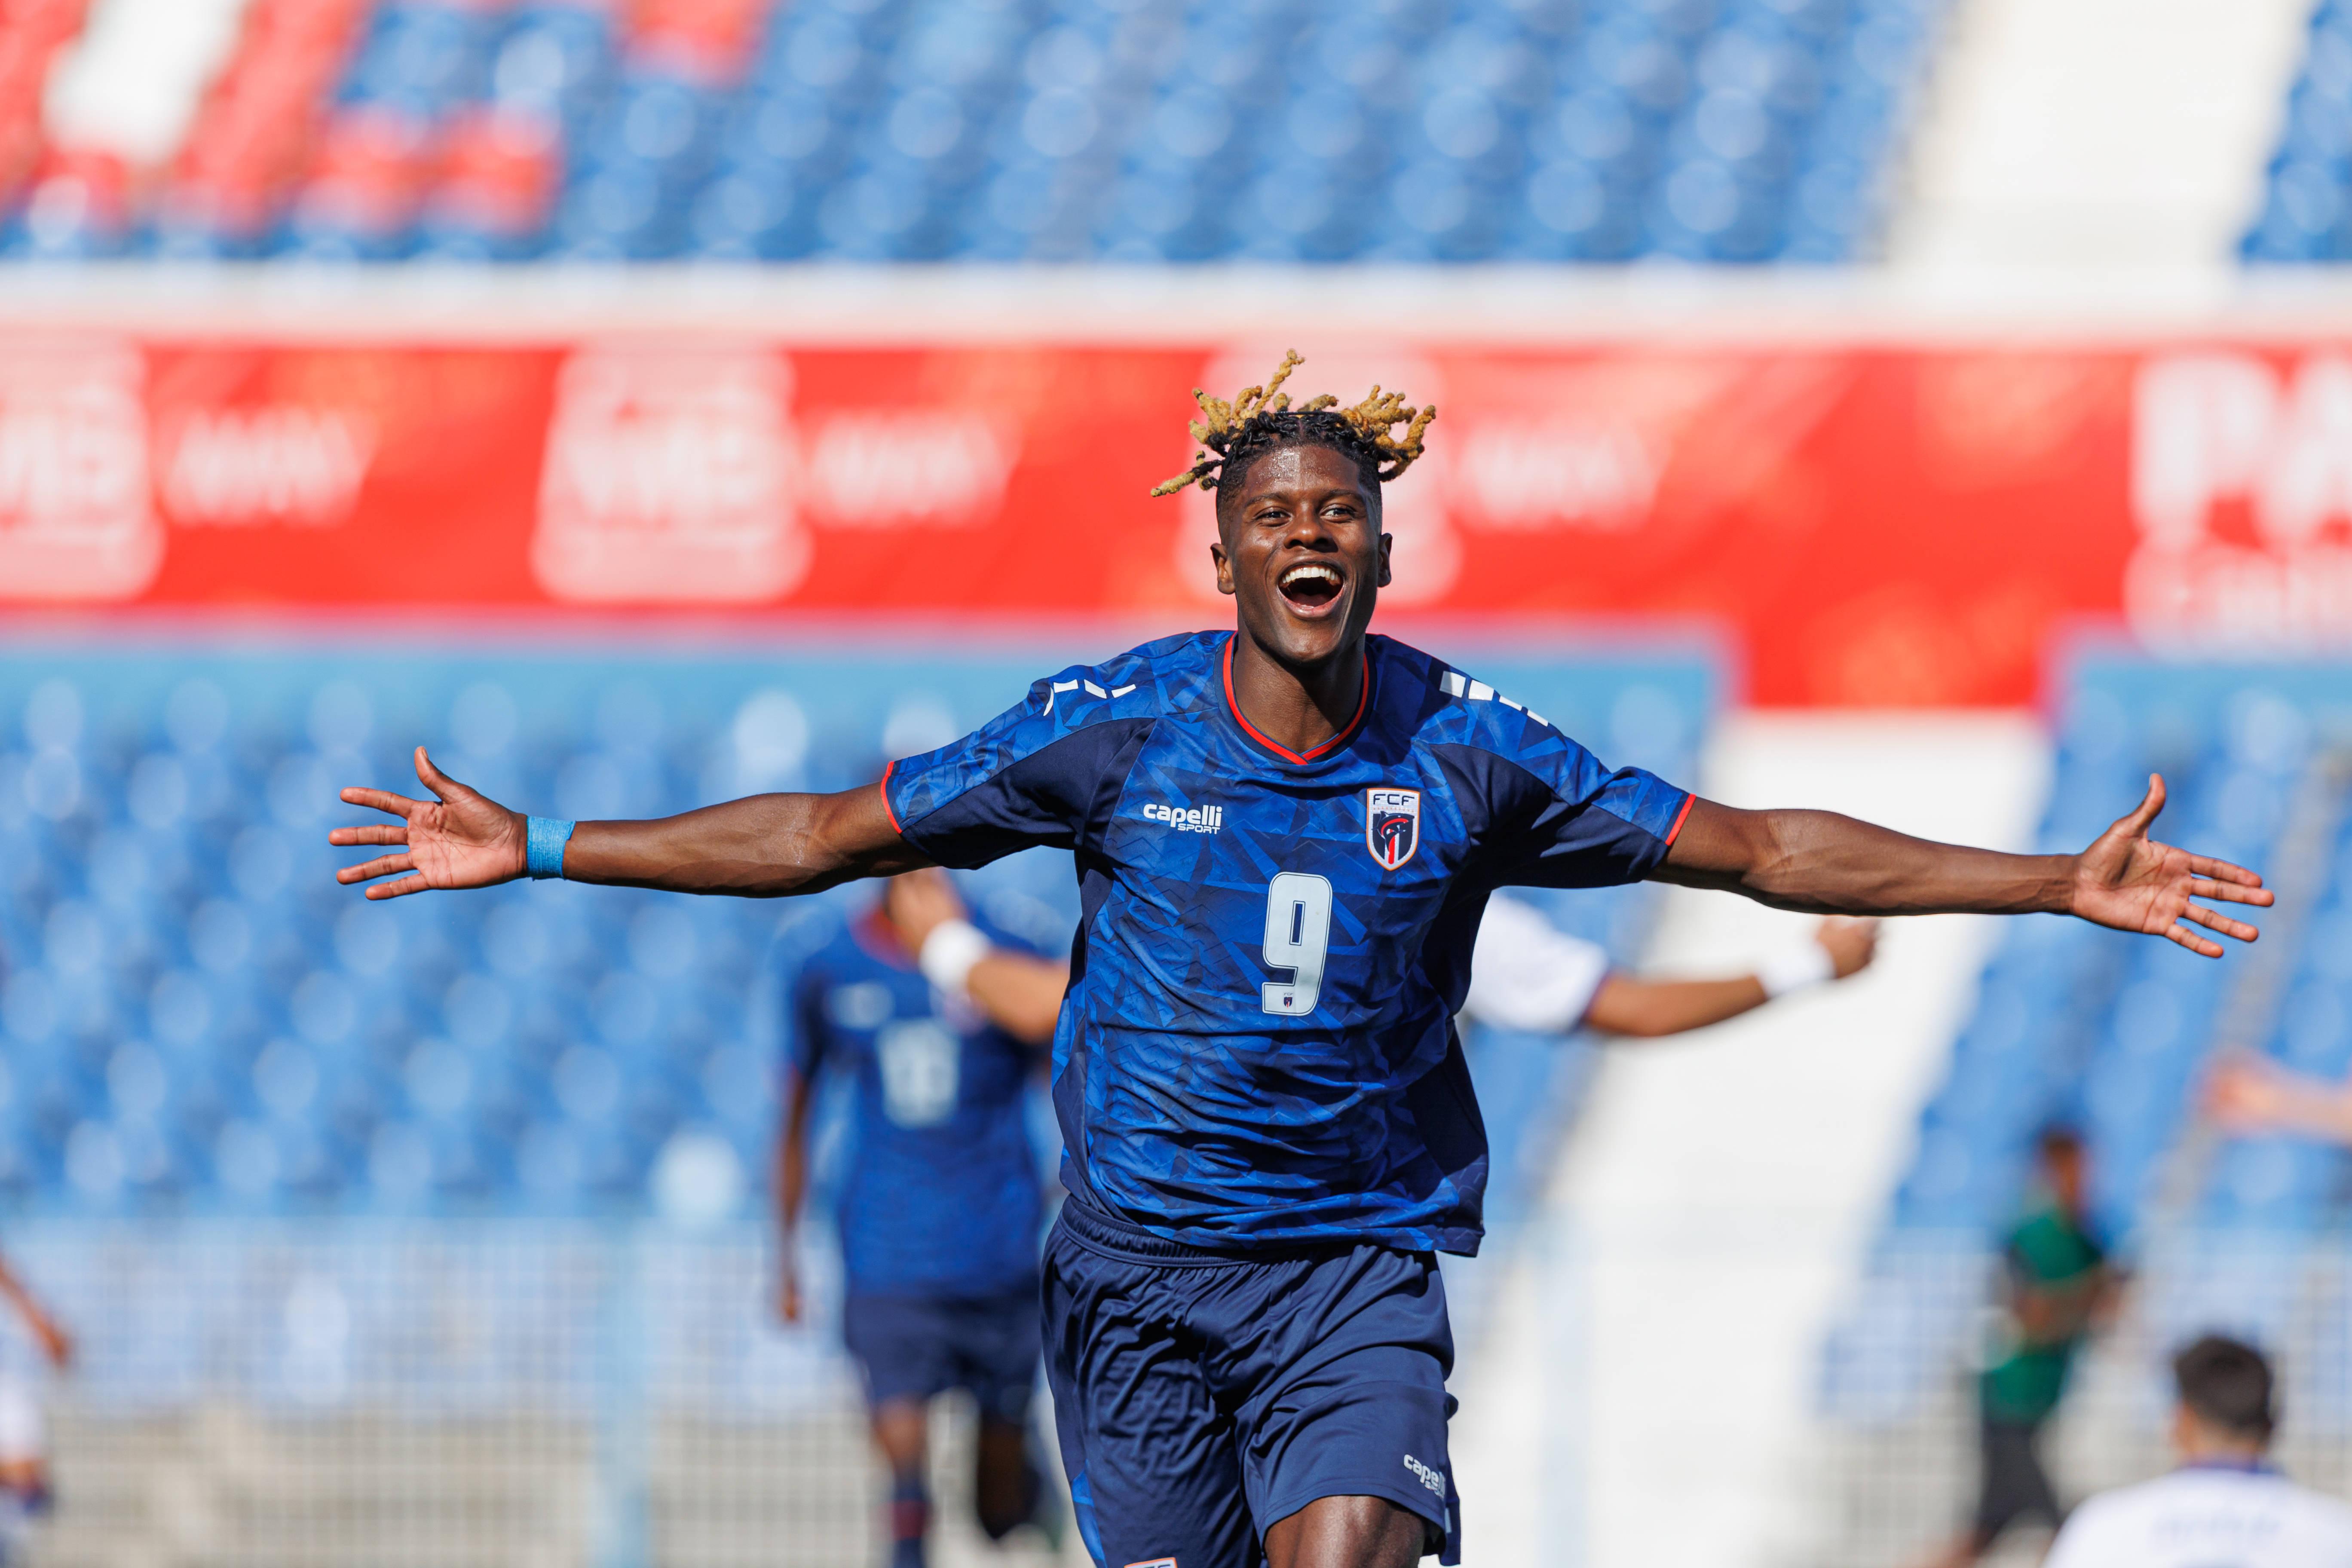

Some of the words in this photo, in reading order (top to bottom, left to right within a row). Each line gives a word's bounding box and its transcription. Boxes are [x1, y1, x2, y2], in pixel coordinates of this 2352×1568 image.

[1373, 793, 1415, 805] FCF
[1143, 803, 1222, 828] capelli
[1177, 823, 1221, 834] SPORT
[1262, 871, 1333, 1016] 9
